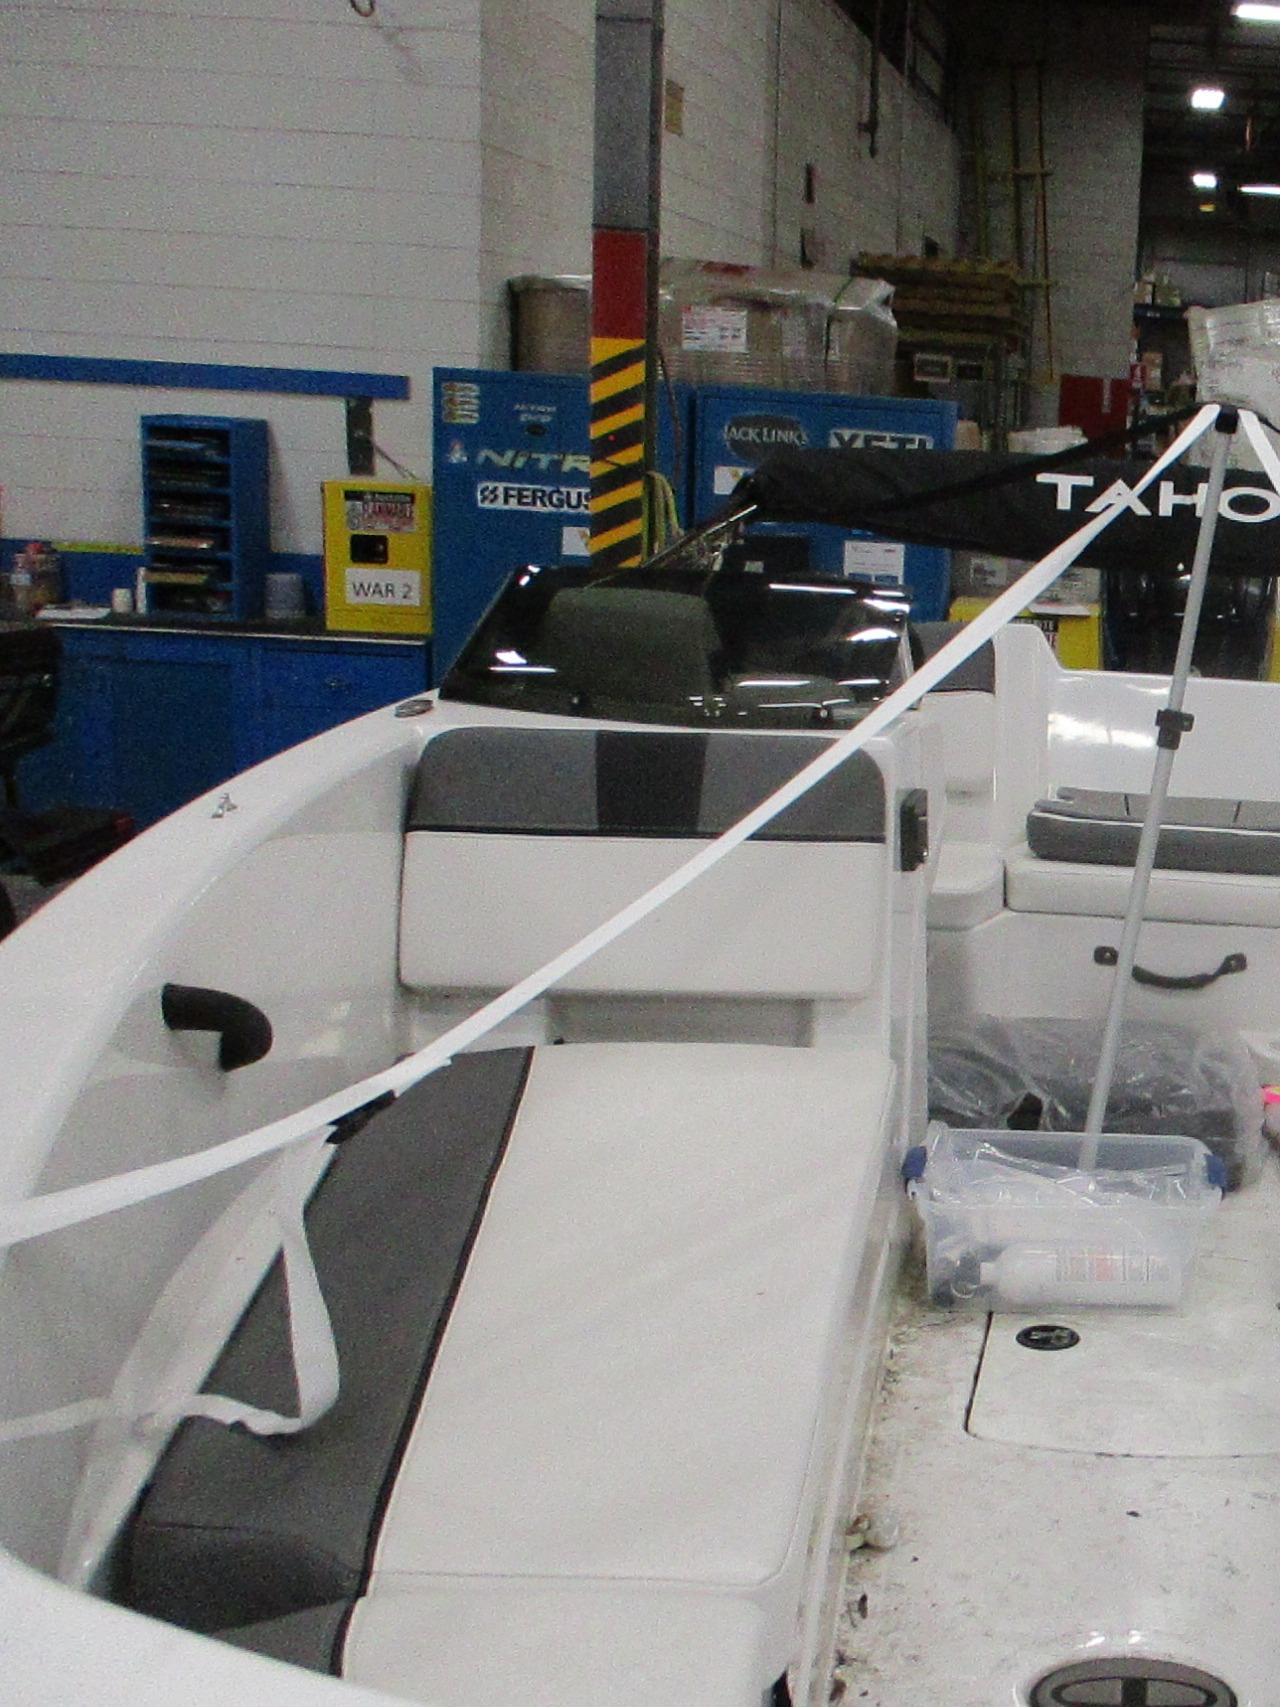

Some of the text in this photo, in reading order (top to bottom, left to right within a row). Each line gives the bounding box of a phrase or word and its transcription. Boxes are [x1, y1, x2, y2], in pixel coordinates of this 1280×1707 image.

[476, 449, 590, 473] NITR
[352, 582, 413, 599] WAR 2
